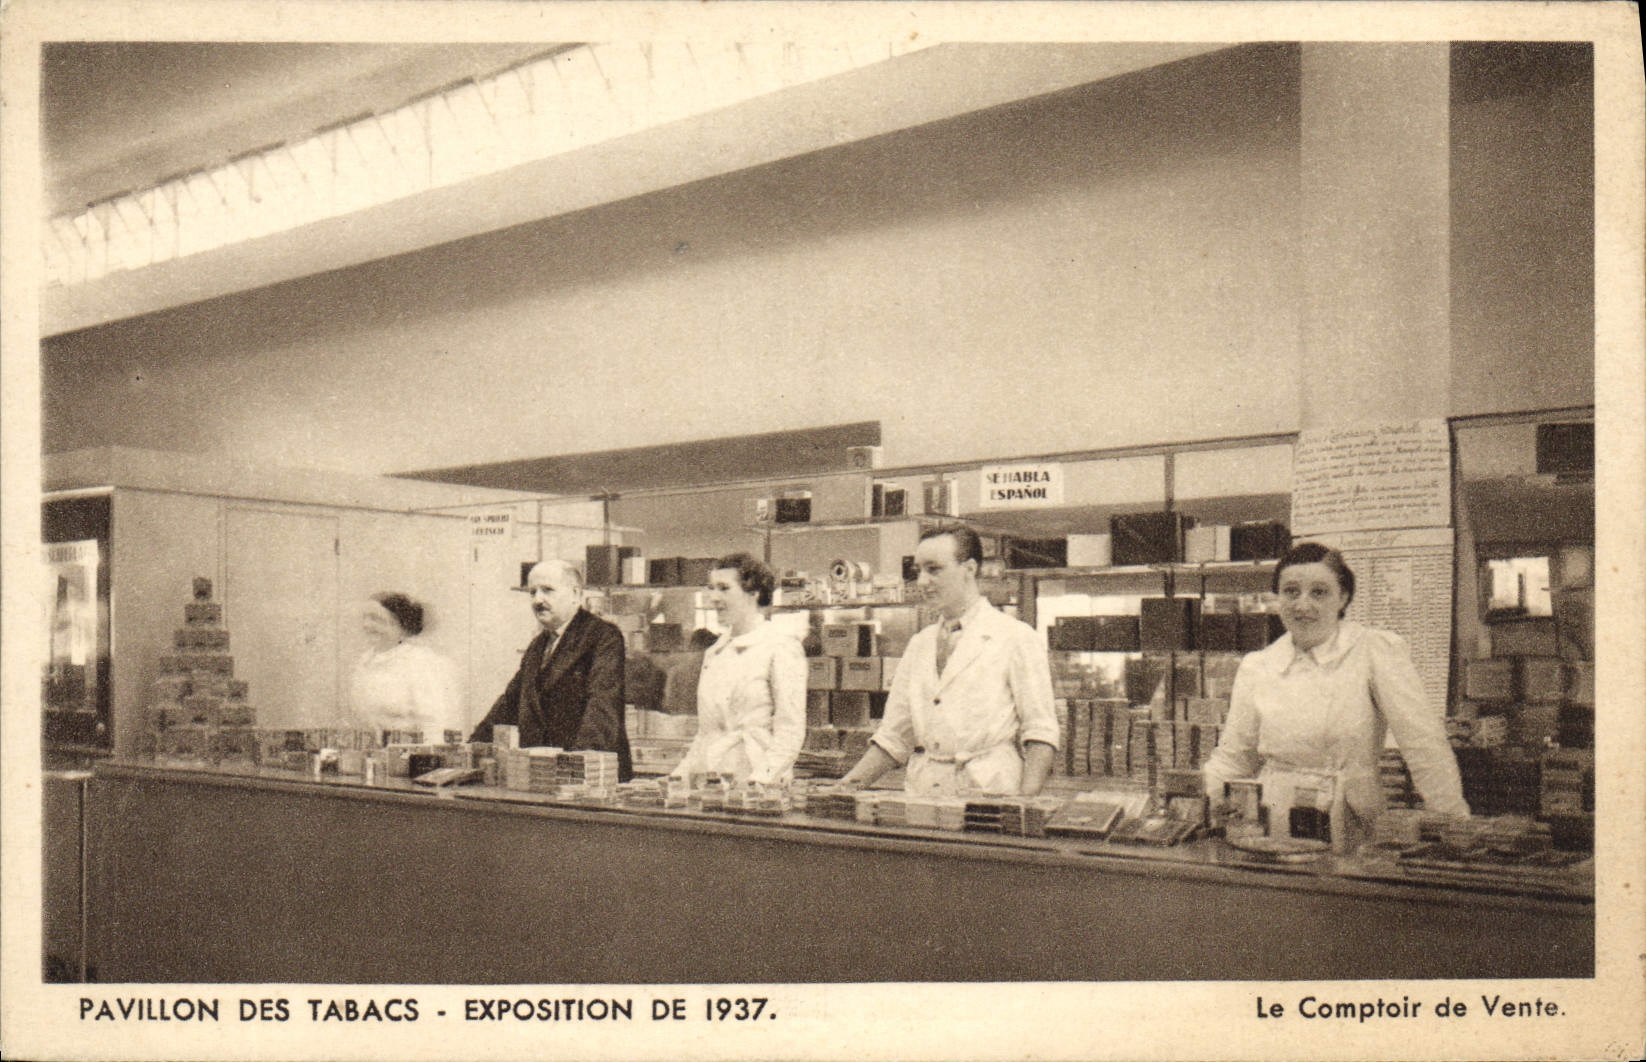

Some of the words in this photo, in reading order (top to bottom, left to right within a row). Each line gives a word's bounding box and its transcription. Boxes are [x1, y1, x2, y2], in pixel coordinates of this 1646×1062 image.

[986, 472, 1000, 484] SE
[1003, 470, 1051, 484] HABLA
[990, 484, 1048, 500] ESPAÑOL
